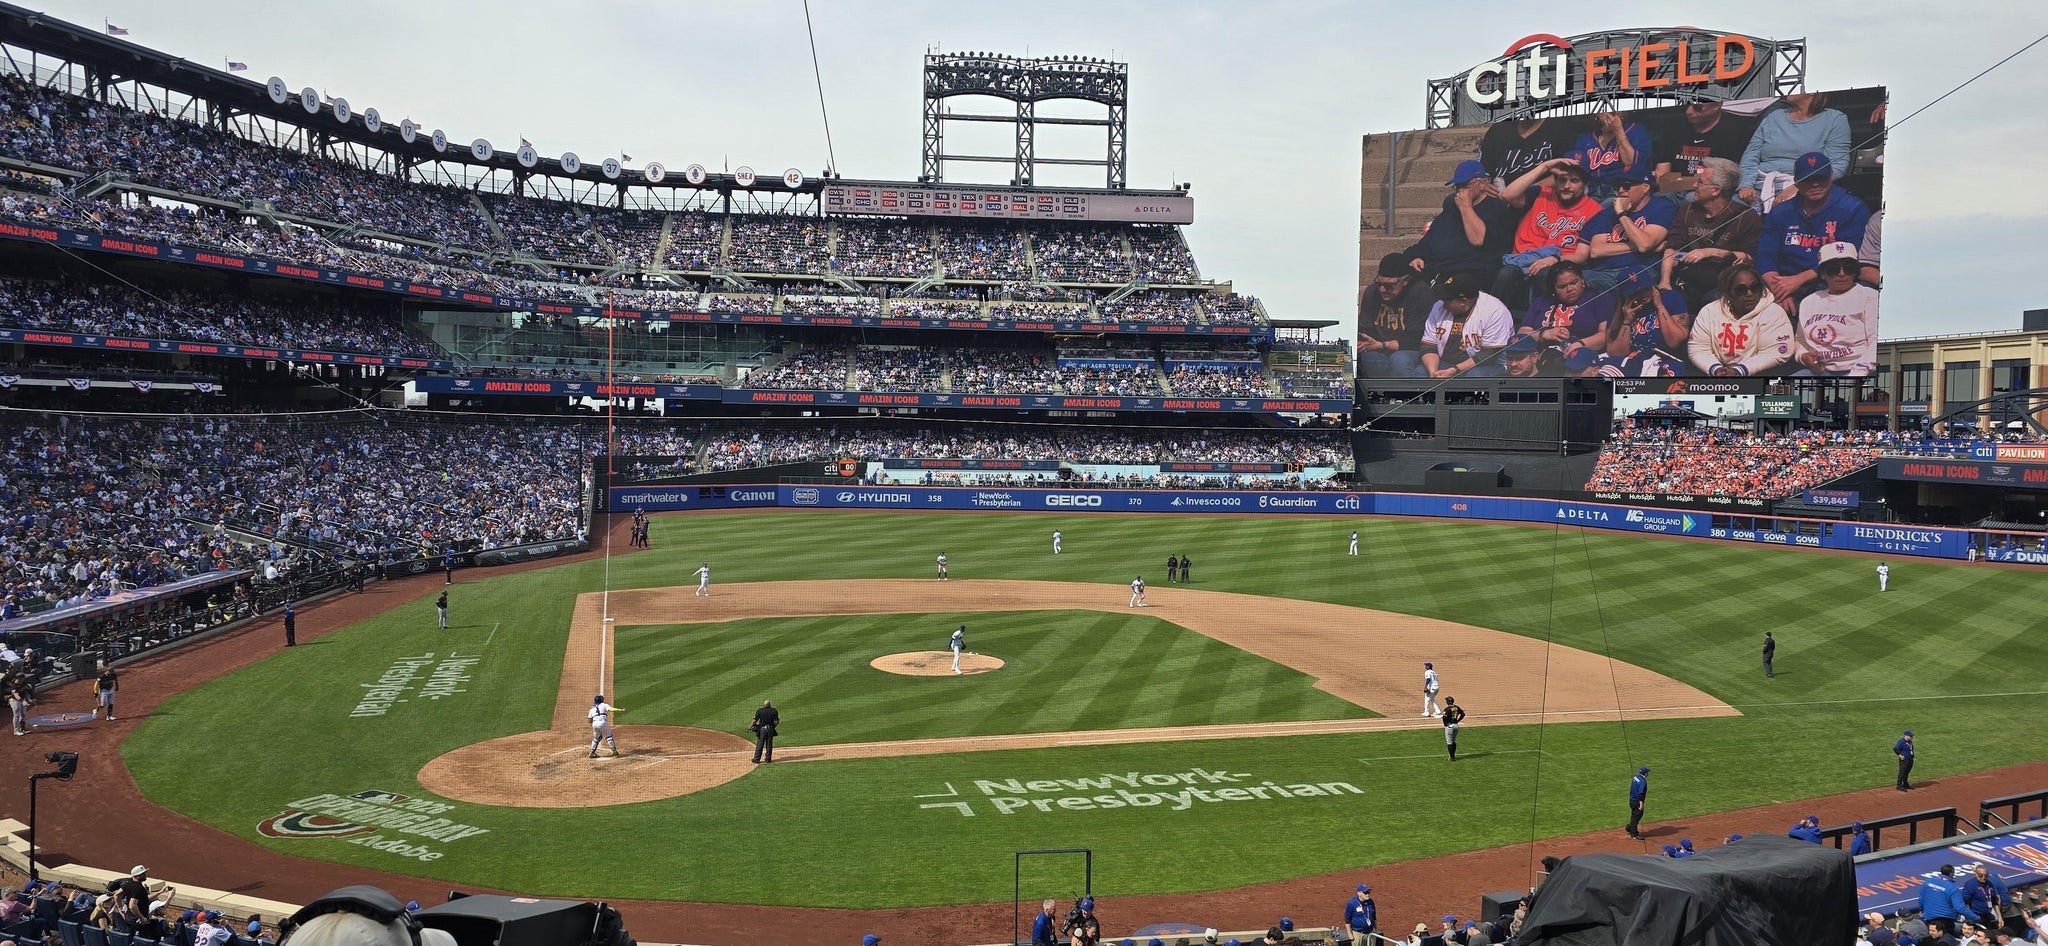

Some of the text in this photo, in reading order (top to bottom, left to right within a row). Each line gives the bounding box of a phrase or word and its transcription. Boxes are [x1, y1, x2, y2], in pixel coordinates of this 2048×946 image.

[1467, 35, 1755, 104] citi FIELD
[275, 84, 280, 95] 5
[306, 95, 315, 107] 18
[338, 104, 347, 116] 16
[367, 116, 378, 126] 24
[404, 125, 412, 136] 17
[435, 135, 444, 147] 36
[477, 144, 487, 155] 31
[522, 151, 532, 161] 41
[565, 158, 575, 168] 14
[606, 163, 616, 174] 37
[736, 172, 753, 180] SHEA
[787, 174, 799, 184] 42
[32, 228, 58, 240] ICONS
[136, 244, 158, 254] ICONS
[224, 257, 244, 267] ICONS
[1804, 314, 1847, 329] NEW YORK
[52, 335, 72, 343] ICONS
[526, 383, 550, 392] ICONS
[632, 386, 656, 395] ICONS
[1690, 383, 1740, 391] moomoo
[790, 393, 814, 402] ICONS
[896, 396, 918, 404] ICONS
[998, 397, 1020, 405] ICONS
[1098, 399, 1120, 407] ICONS
[1198, 401, 1220, 409] ICONS
[1296, 402, 1320, 410] ICONS
[1998, 448, 2046, 458] PAVILION
[824, 463, 838, 472] citi
[1904, 464, 1978, 479] AMAZIN' ICONS
[621, 494, 680, 503] smartwater
[730, 490, 776, 502] Canon
[858, 494, 911, 503] HYUNDAI
[1046, 495, 1102, 506] GEICO
[1596, 492, 1621, 500] HubSpot
[1707, 496, 1731, 504] HubSpot
[1812, 496, 1848, 505] $39,845
[1222, 498, 1241, 506] QQQ
[1270, 497, 1316, 507] Guardian
[1336, 497, 1360, 509] citi
[1738, 498, 1763, 507] HubSpot
[1568, 509, 1608, 521] DELTA
[1644, 516, 1681, 526] HAUGLAND
[1710, 529, 1725, 537] 380
[1733, 531, 1755, 539] GOYA
[1764, 533, 1786, 541] GOYA
[1854, 528, 1942, 543] HENDRICK'S
[1796, 536, 1819, 544] GOYA
[1885, 543, 1910, 551] GIN
[2016, 552, 2048, 563] DUN
[349, 660, 434, 718] Presbyterian
[974, 767, 1252, 797] NewYork-
[990, 781, 1365, 815] Presbyterian
[288, 794, 490, 843] OPENING DAY
[348, 834, 444, 862] Adobe
